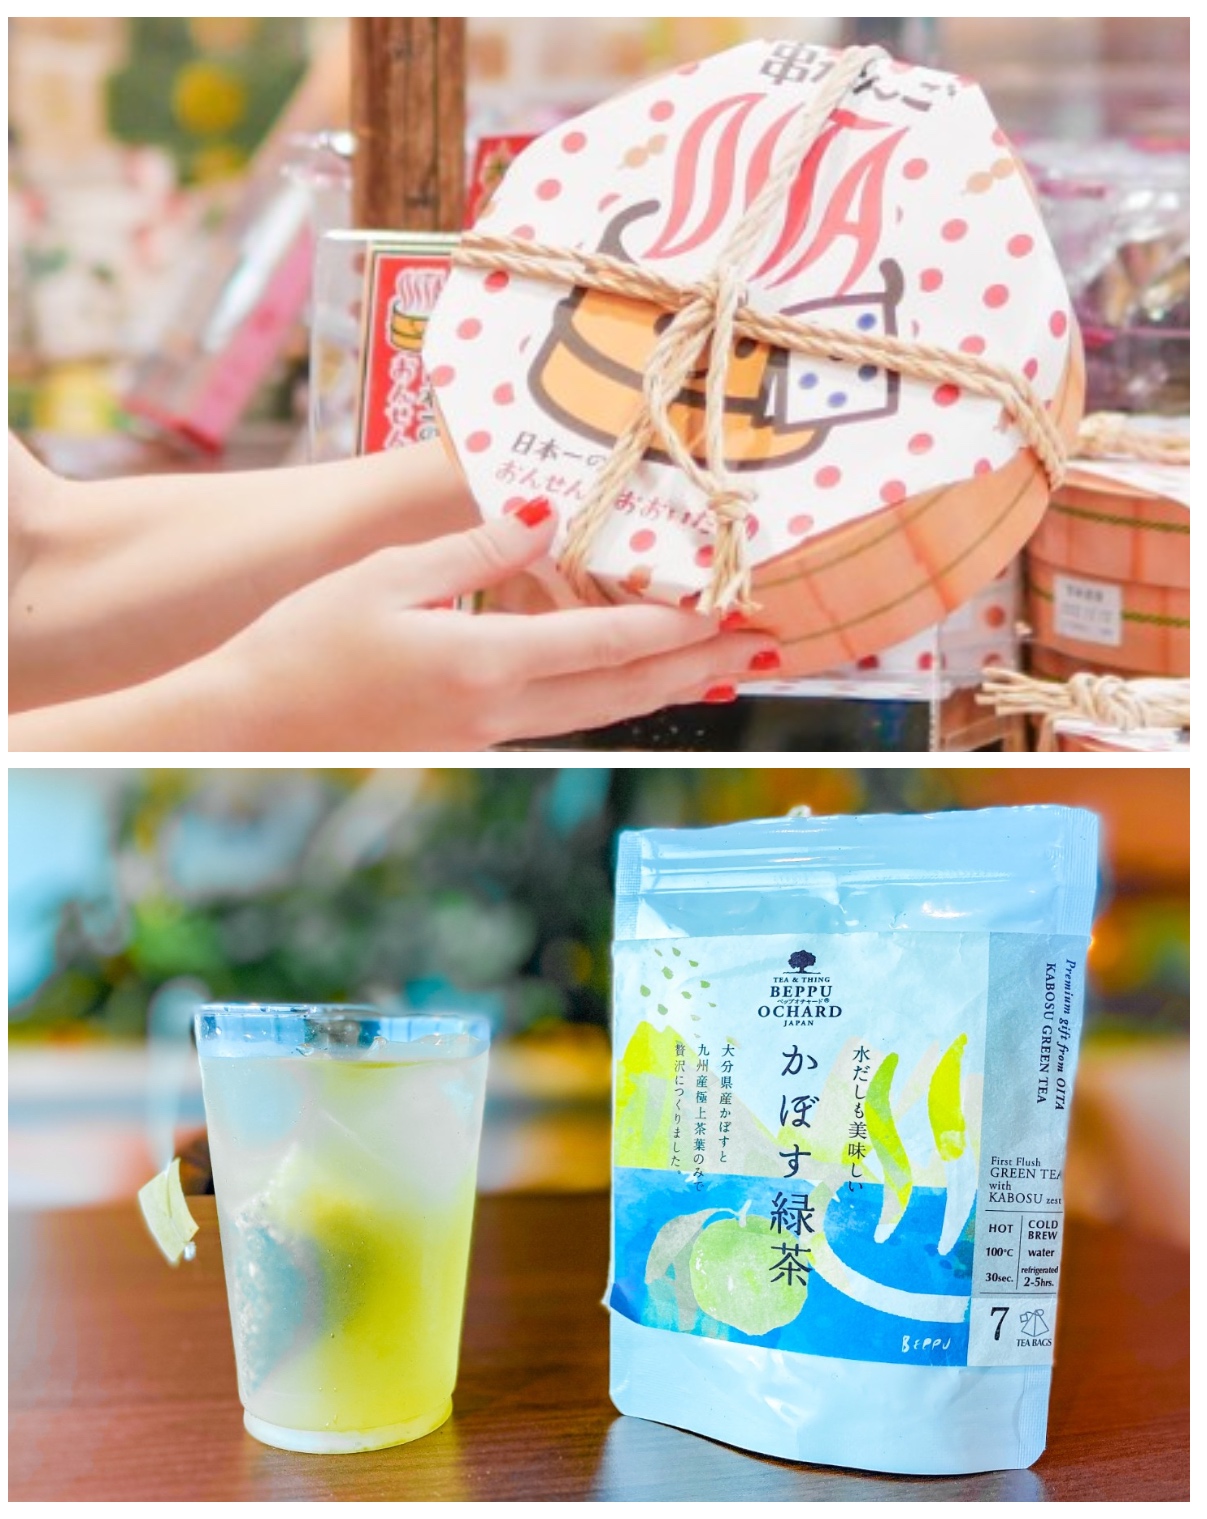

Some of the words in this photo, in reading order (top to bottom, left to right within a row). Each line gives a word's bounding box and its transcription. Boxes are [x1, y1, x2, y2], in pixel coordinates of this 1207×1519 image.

[770, 985, 833, 997] BEPPU
[1043, 962, 1057, 1021] KABOSU
[1064, 959, 1076, 1015] Premium
[758, 1005, 842, 1017] OCHARD
[1059, 1018, 1071, 1040] gift
[1040, 1025, 1053, 1073] GREEN
[1057, 1041, 1069, 1073] from
[1037, 1077, 1049, 1104] TEA
[1055, 1077, 1066, 1110] OITA
[718, 1044, 735, 1163] 大分県産かぼすと
[670, 1044, 686, 1177] 贅沢につくりました。
[693, 1044, 710, 1192] 九州産極上茶葉のみで
[847, 1045, 871, 1192] 水だしも美味しい
[768, 1044, 819, 1287] かぼす緑茶
[991, 1156, 1012, 1166] First
[1016, 1157, 1041, 1167] Flush
[990, 1167, 1036, 1179] GREEN
[989, 1181, 1012, 1190] with
[989, 1192, 1043, 1204] KABOSU
[989, 1224, 1013, 1233] HOT
[1028, 1220, 1058, 1229] COLD
[1028, 1231, 1058, 1240] BREW
[986, 1247, 1013, 1257] 100°C
[1028, 1249, 1054, 1257] water
[1021, 1266, 1058, 1276] refrigerated
[985, 1273, 1013, 1282] 30sec.
[1023, 1277, 1054, 1287] 2-5hrs.
[990, 1306, 1010, 1341] 7
[1016, 1339, 1030, 1347] TEA
[1032, 1338, 1052, 1347] BAGS
